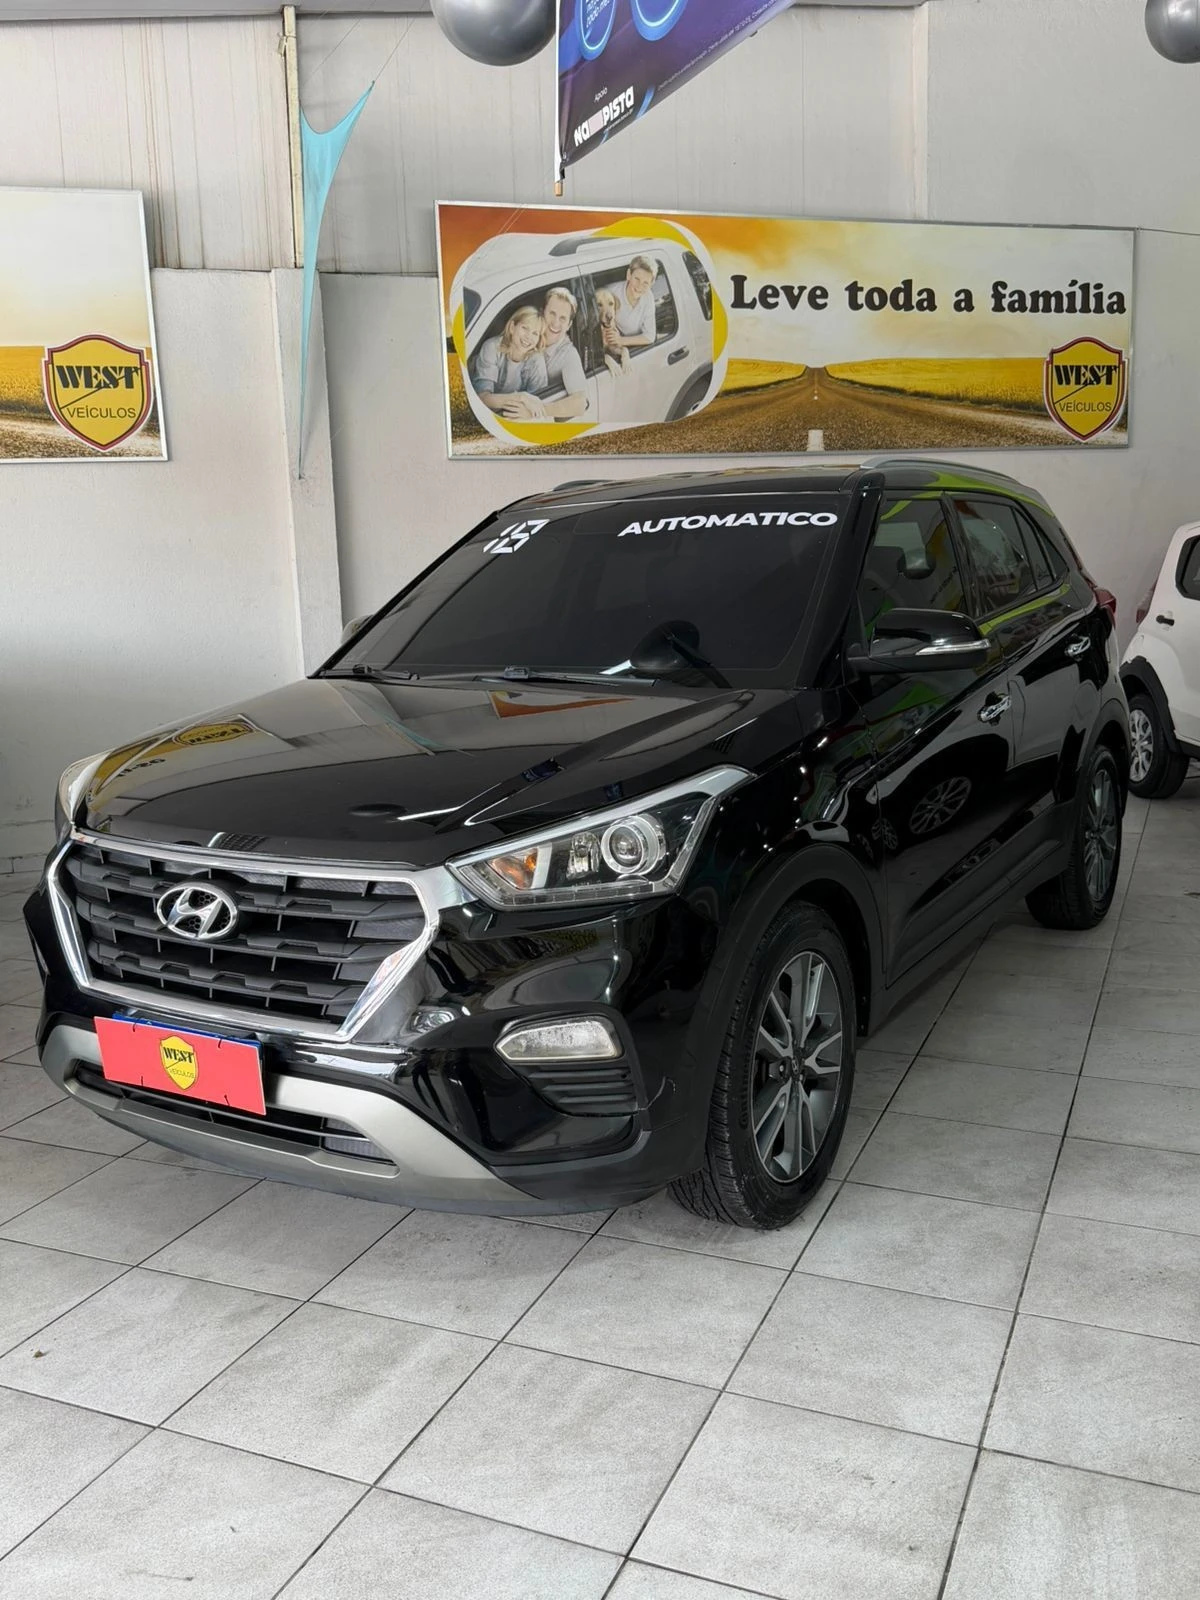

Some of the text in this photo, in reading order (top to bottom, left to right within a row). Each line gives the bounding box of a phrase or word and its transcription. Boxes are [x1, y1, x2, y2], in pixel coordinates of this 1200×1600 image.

[730, 274, 1127, 314] Leve toda a família
[55, 365, 140, 389] WEST
[1054, 364, 1120, 386] WEST
[66, 405, 136, 419] VEÍCULOS
[1059, 400, 1112, 413] VEÍCULOS
[617, 511, 838, 537] AUTOMATICO
[163, 1047, 194, 1063] WEST
